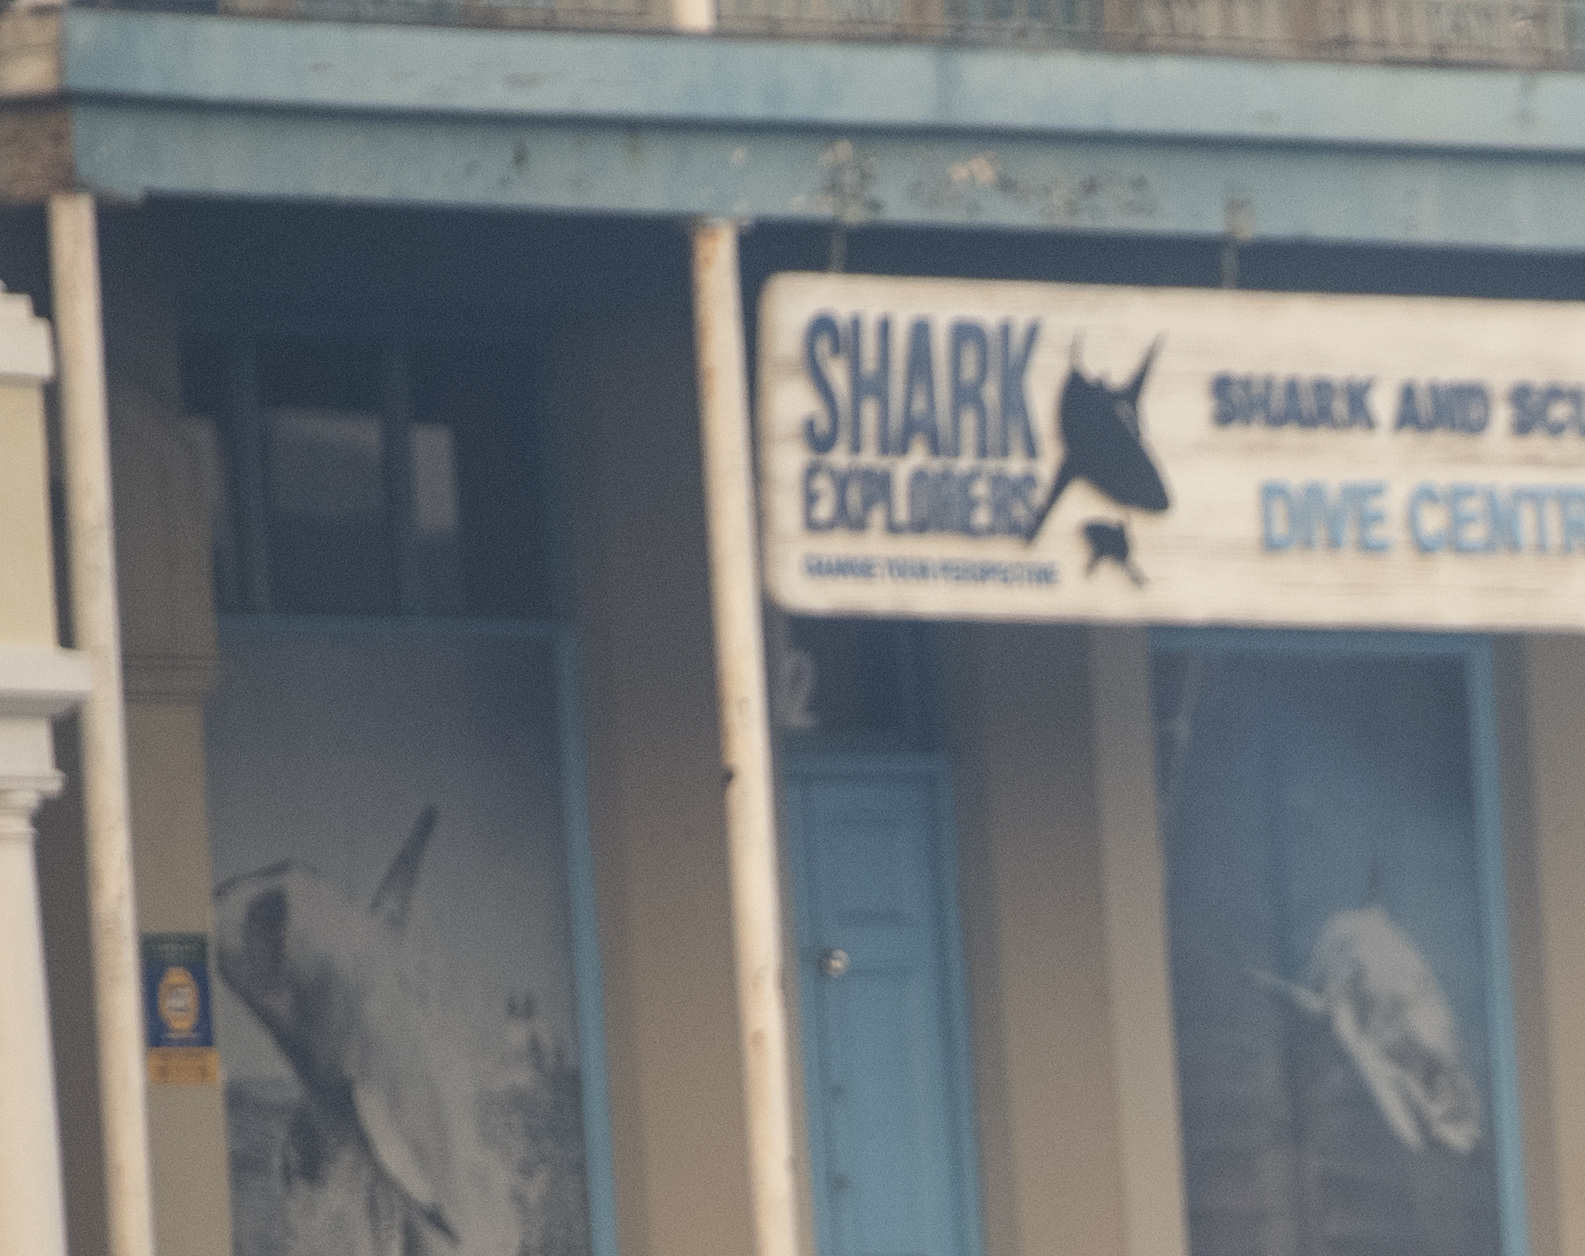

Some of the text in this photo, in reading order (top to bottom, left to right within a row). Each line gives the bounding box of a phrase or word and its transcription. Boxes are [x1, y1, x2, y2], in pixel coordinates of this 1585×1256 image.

[803, 309, 1040, 456] SHARK
[1211, 371, 1376, 430] SHARK
[1394, 377, 1493, 434] AND
[803, 461, 1038, 537] EXPLORERS
[1261, 478, 1391, 553] DIVE
